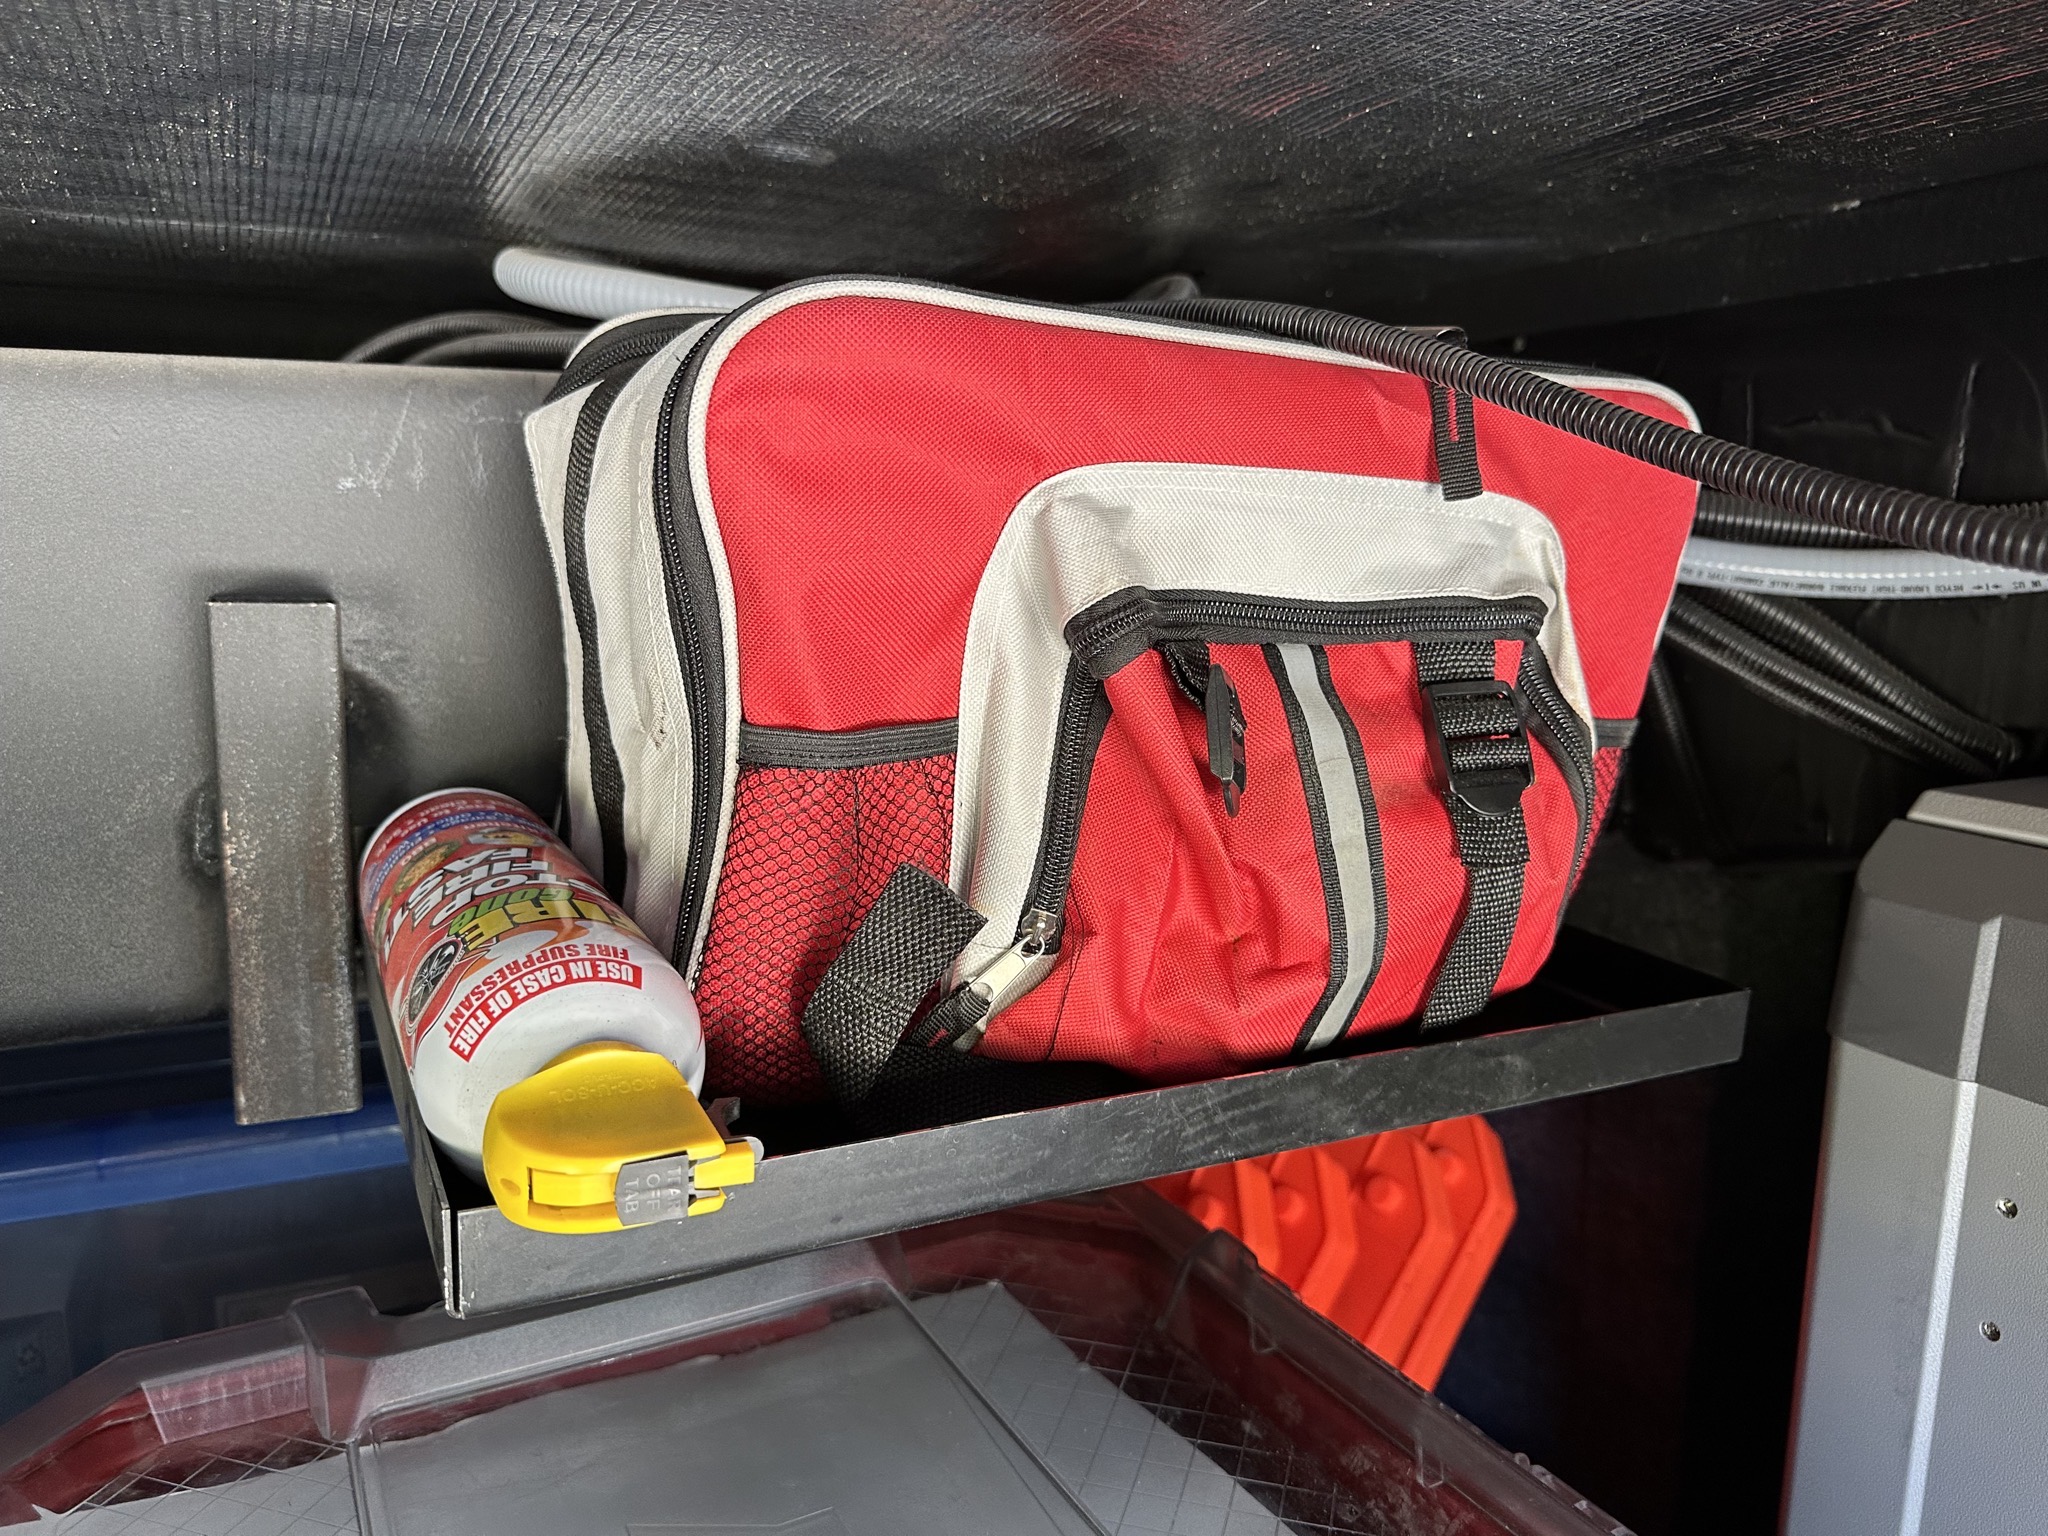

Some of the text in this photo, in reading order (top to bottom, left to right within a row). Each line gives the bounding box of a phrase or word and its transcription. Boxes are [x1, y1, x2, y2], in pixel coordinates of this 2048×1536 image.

[412, 861, 549, 929] FIRE
[431, 873, 610, 927] STOP
[458, 899, 643, 951] FIRE
[443, 943, 630, 1039] FIRE SUPPRESSANT
[453, 960, 634, 1056] USE IN CASE OF FIRE
[624, 1177, 639, 1214] TAB
[646, 1174, 661, 1211] OFF
[667, 1166, 682, 1215] TEAR
